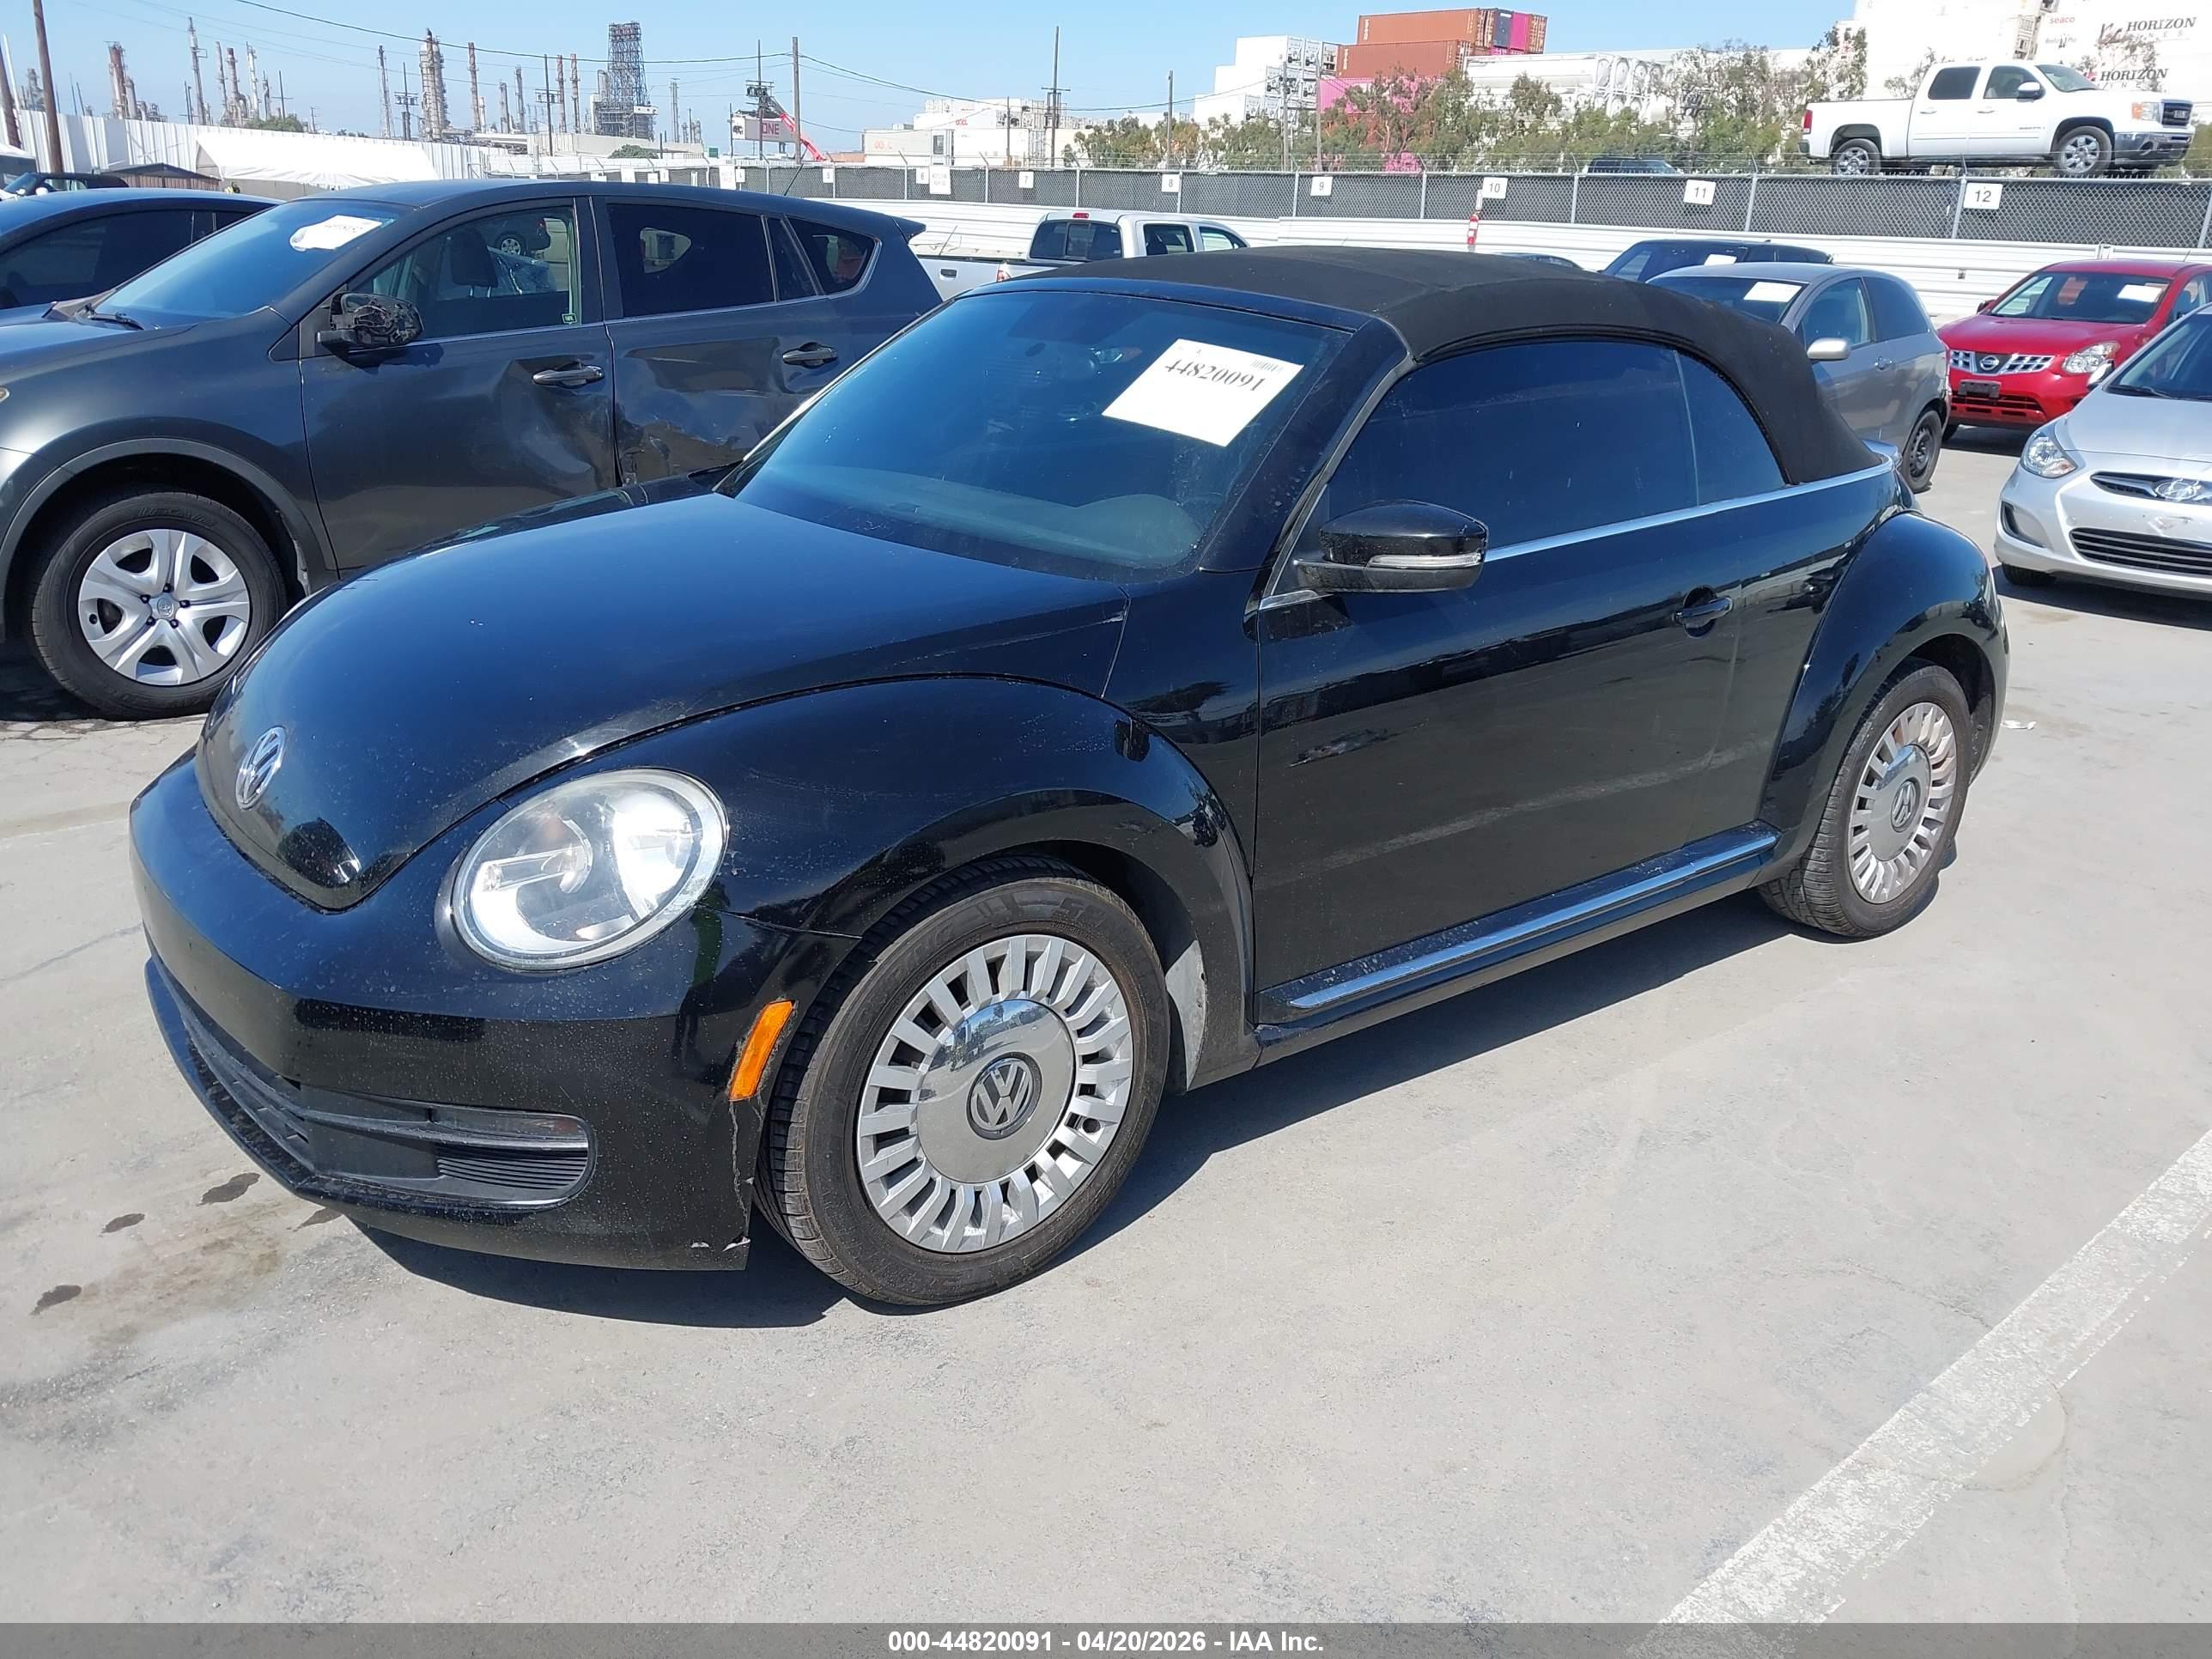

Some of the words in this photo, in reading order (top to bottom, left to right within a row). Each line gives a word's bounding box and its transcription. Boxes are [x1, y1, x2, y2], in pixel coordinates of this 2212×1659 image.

[2126, 17, 2197, 32] HORIZON
[2100, 69, 2169, 82] HORIZON
[1023, 175, 1030, 185] 7
[1167, 178, 1174, 188] 8
[1318, 181, 1325, 191] 9
[1489, 183, 1501, 193] 10
[1694, 186, 1707, 198] 11
[1975, 190, 1991, 203] 12
[1164, 358, 1267, 392] 44820091
